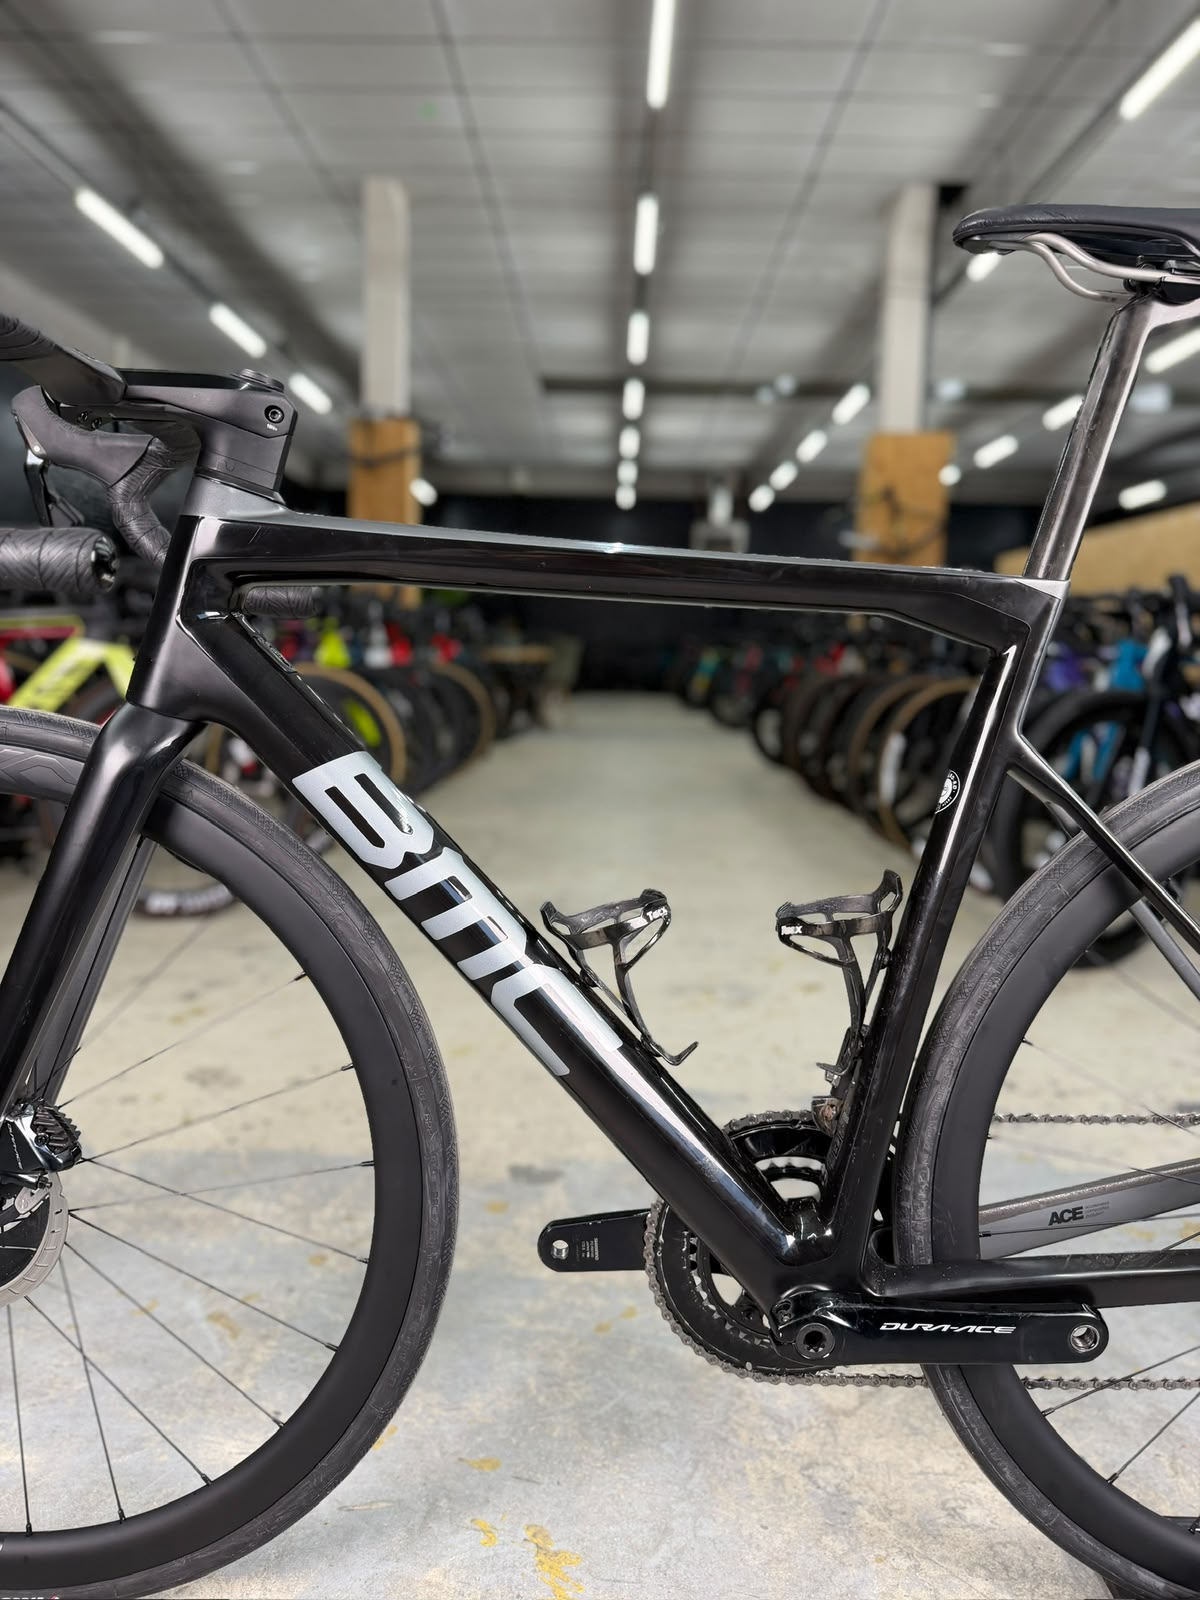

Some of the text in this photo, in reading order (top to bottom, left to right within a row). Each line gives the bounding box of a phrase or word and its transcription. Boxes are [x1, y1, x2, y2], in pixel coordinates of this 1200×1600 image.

[292, 751, 623, 1076] BMC
[1048, 1206, 1084, 1226] ACE
[879, 1322, 1017, 1334] DURA-ACE
